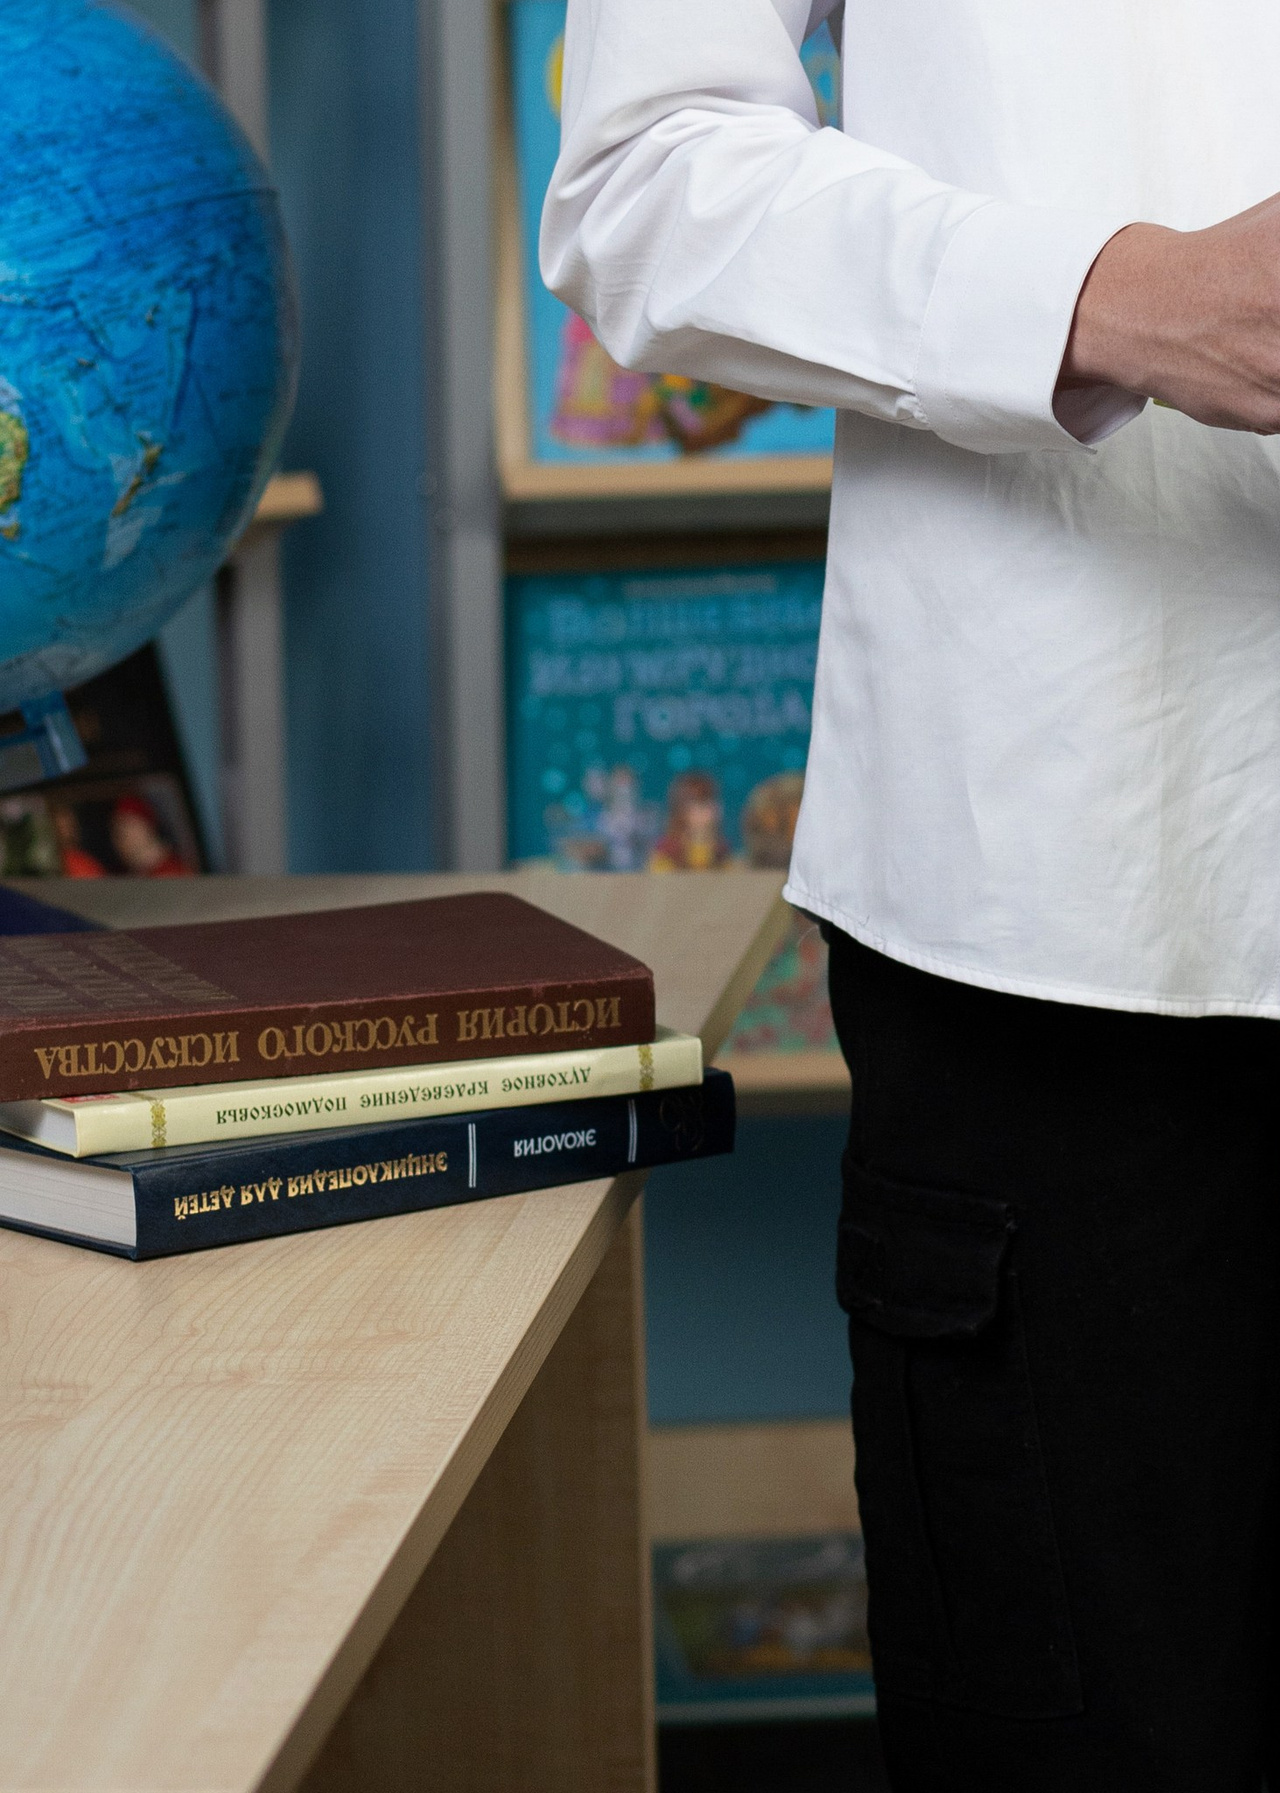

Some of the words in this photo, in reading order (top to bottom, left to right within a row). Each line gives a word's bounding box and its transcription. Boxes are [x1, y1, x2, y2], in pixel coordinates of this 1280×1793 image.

[456, 996, 622, 1042] ИСТОРИЯ
[257, 1012, 440, 1060] РУССКОГО
[34, 1031, 241, 1080] ИСКУССТВА
[360, 1080, 489, 1108] КРАЕВЕДЕНИЕ
[501, 1066, 592, 1093] ДУХОВНОЕ
[216, 1096, 348, 1125] ПОДМОСКОВЬЯ
[513, 1128, 597, 1158] ЭКОЛОГИЯ
[240, 1176, 284, 1206] ДЛЯ
[287, 1150, 449, 1199] ЭНЦИКЛОПЕДИЯ
[173, 1184, 236, 1221] ДЕТЕЙ
